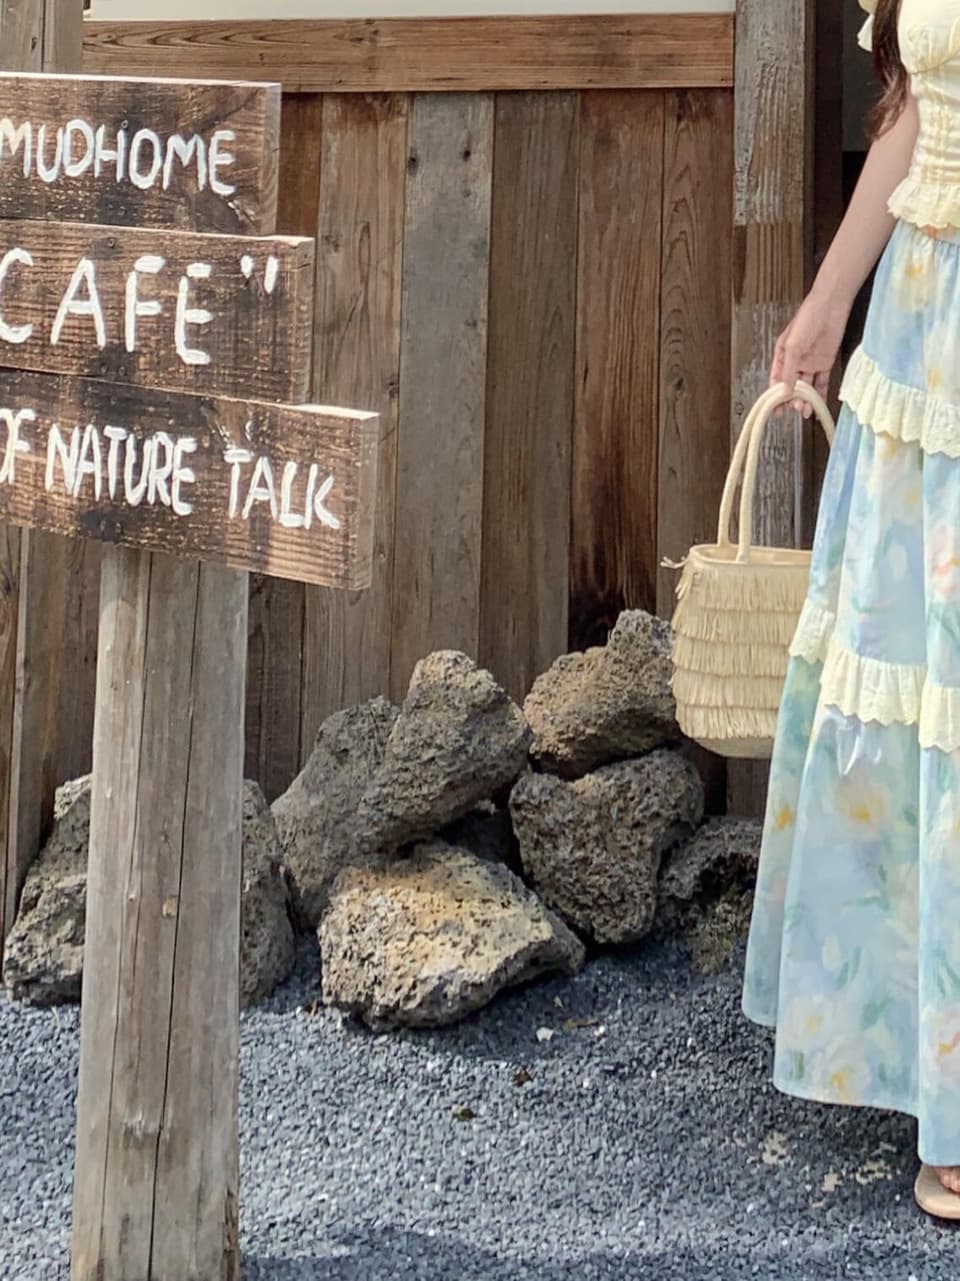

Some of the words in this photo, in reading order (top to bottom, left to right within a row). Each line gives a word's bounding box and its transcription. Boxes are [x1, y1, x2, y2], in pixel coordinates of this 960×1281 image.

[0, 119, 236, 195] MUDHOME
[45, 424, 196, 516] NATURE
[223, 448, 340, 530] TALK
